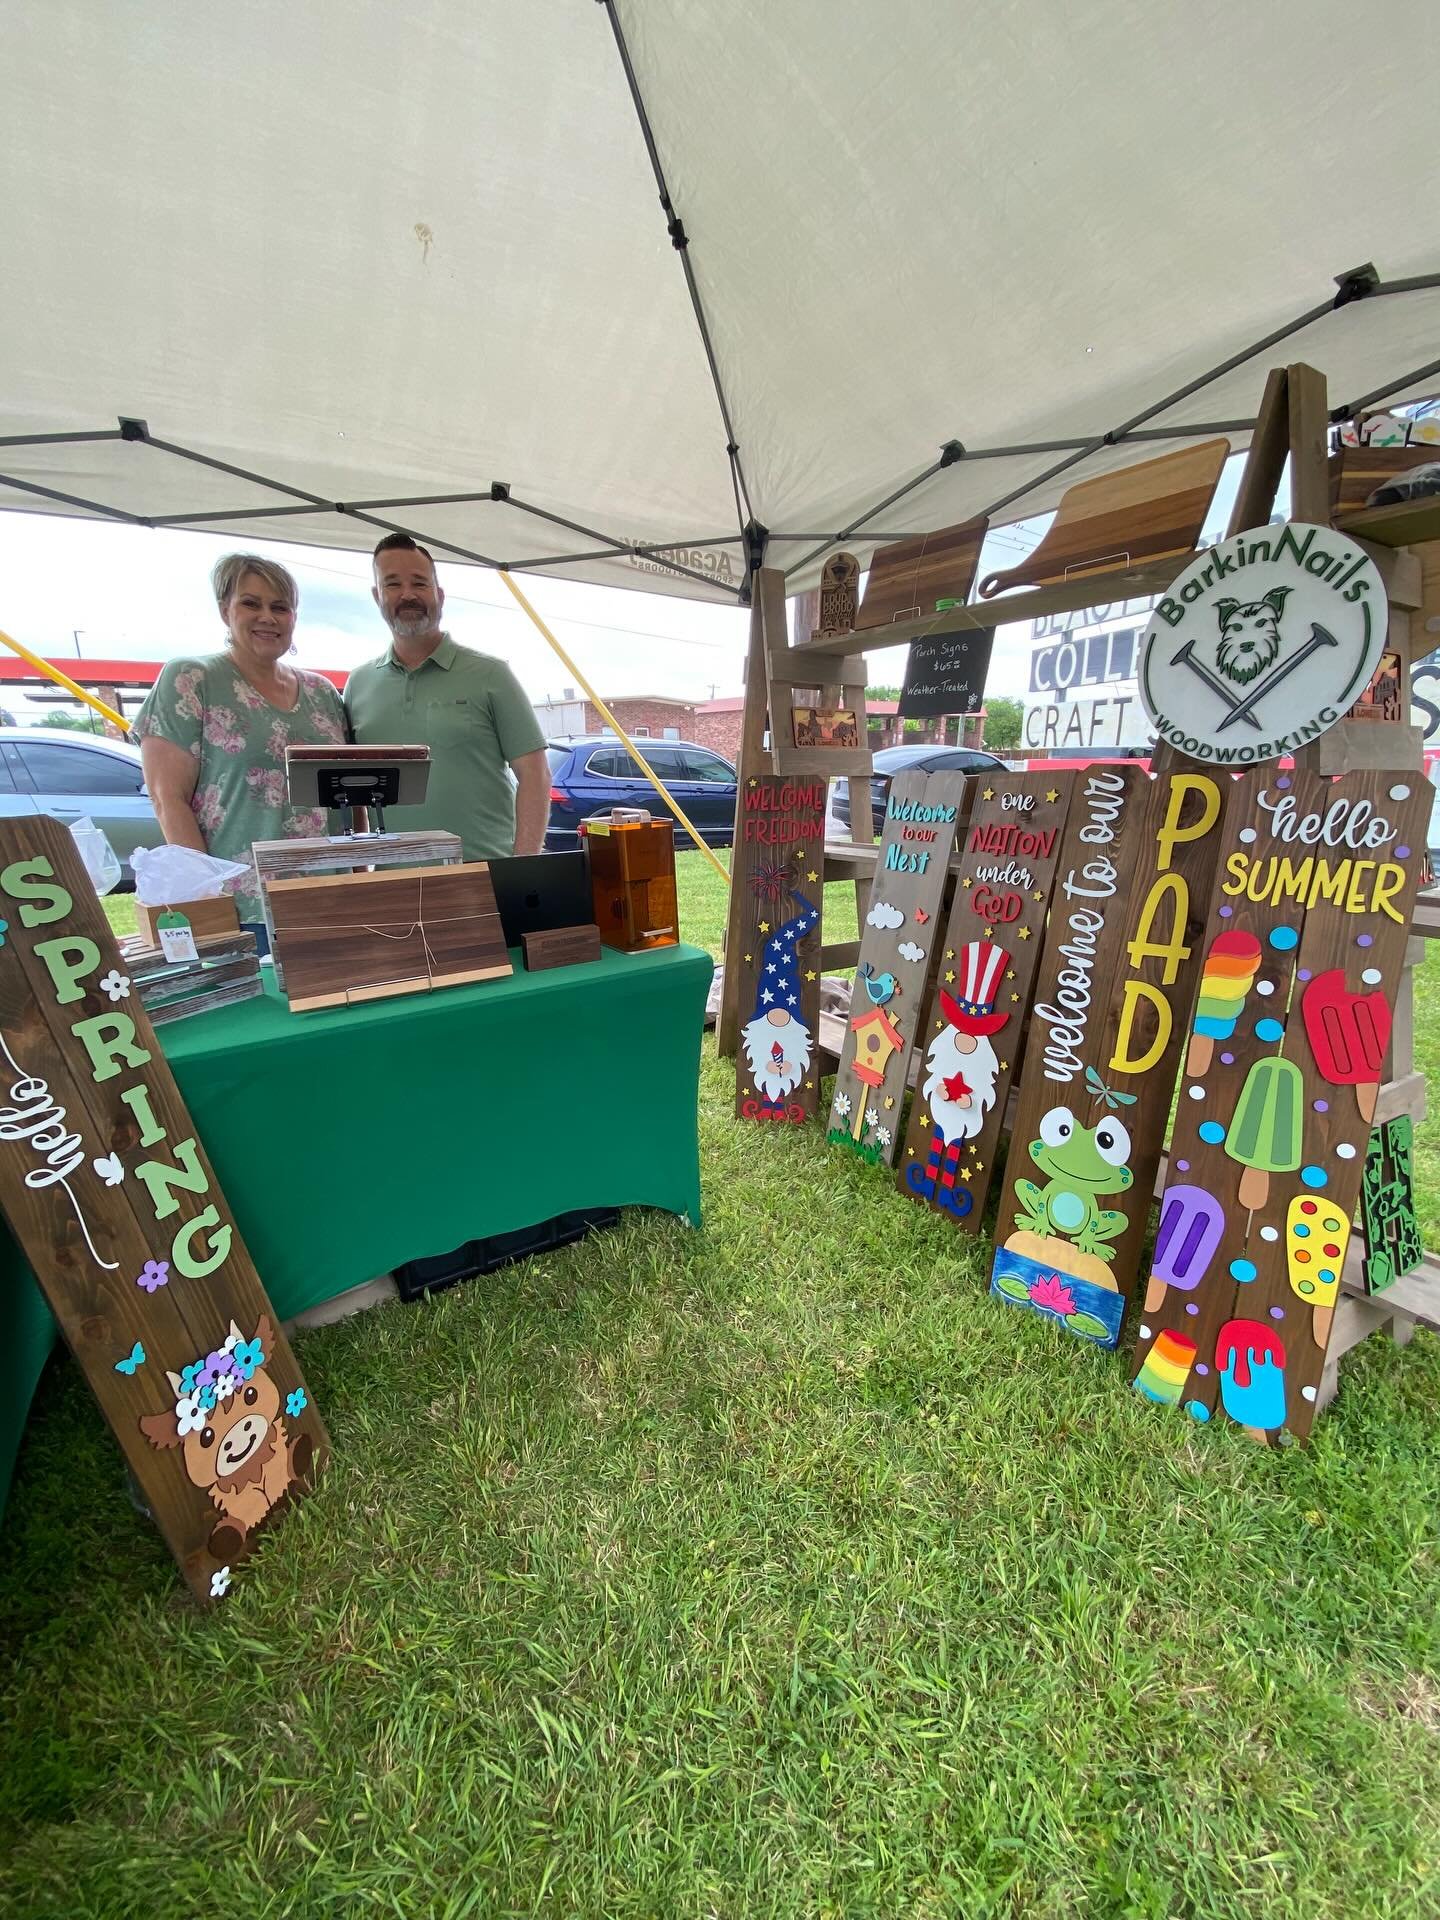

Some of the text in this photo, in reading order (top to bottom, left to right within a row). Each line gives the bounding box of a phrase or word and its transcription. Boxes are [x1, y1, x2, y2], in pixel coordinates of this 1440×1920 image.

[1155, 525, 1370, 627] BarkinNails
[911, 642, 969, 658] Porch Signs
[907, 679, 969, 696] Weather-Treated
[1026, 697, 1133, 748] CRAFT
[1155, 706, 1338, 762] WOODWORKING
[744, 783, 825, 813] WELCOME
[887, 795, 956, 824] Welcome
[1001, 792, 1035, 812] one
[744, 816, 825, 846] FREEDOM
[902, 825, 938, 843] to our
[1257, 790, 1398, 849] hello
[969, 823, 1057, 860] NATION
[884, 843, 930, 875] Nest
[976, 861, 1034, 890] under
[1222, 852, 1406, 924] SUMMER
[1033, 772, 1125, 1083] welcome to our
